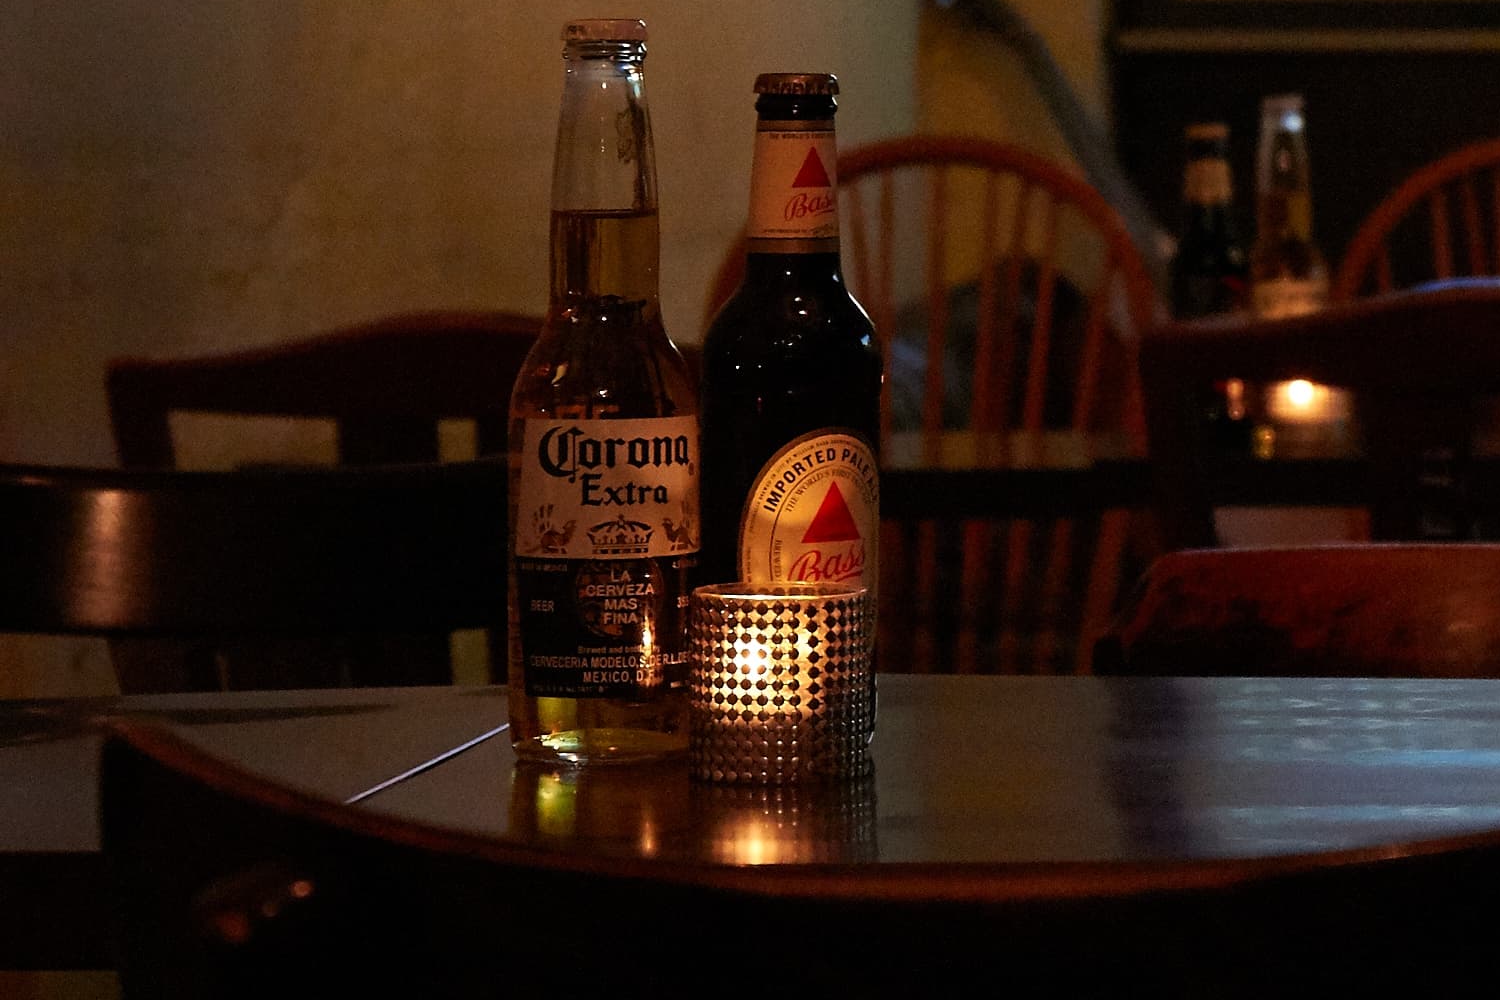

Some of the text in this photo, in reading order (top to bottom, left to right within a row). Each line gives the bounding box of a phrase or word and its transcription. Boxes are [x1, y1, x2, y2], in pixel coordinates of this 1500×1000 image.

[539, 426, 690, 483] Corona
[764, 448, 836, 512] IMPORTED
[842, 449, 869, 475] PALE
[581, 473, 668, 506] Extra
[610, 570, 632, 583] LA
[585, 584, 655, 598] CERVEZA
[530, 599, 555, 613] BEER
[604, 598, 638, 611] MAS
[603, 612, 639, 625] FINA
[530, 655, 587, 669] CERVECERIA
